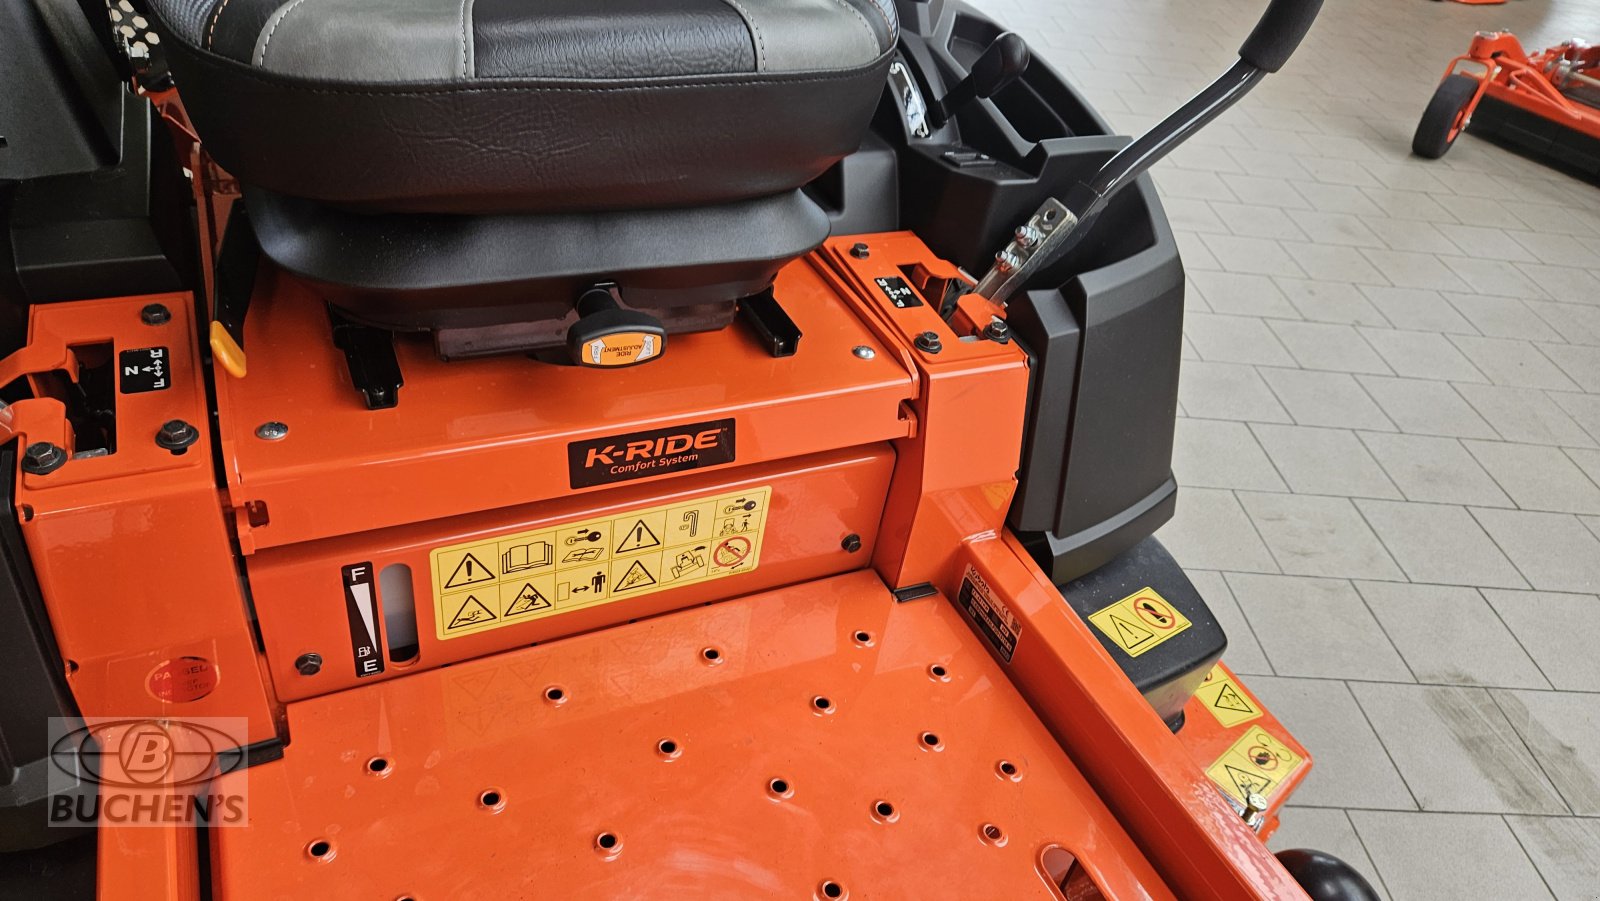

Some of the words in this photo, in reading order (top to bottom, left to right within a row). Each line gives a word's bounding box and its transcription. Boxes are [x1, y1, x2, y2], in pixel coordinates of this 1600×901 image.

[150, 348, 163, 358] R
[603, 344, 643, 353] ADJUSTMENT
[615, 350, 632, 358] RIDE
[125, 365, 138, 376] N
[153, 378, 165, 388] F
[585, 428, 722, 468] K-RIDE
[610, 459, 656, 475] Comfort
[659, 453, 699, 468] System
[351, 566, 366, 582] F
[363, 659, 378, 673] E
